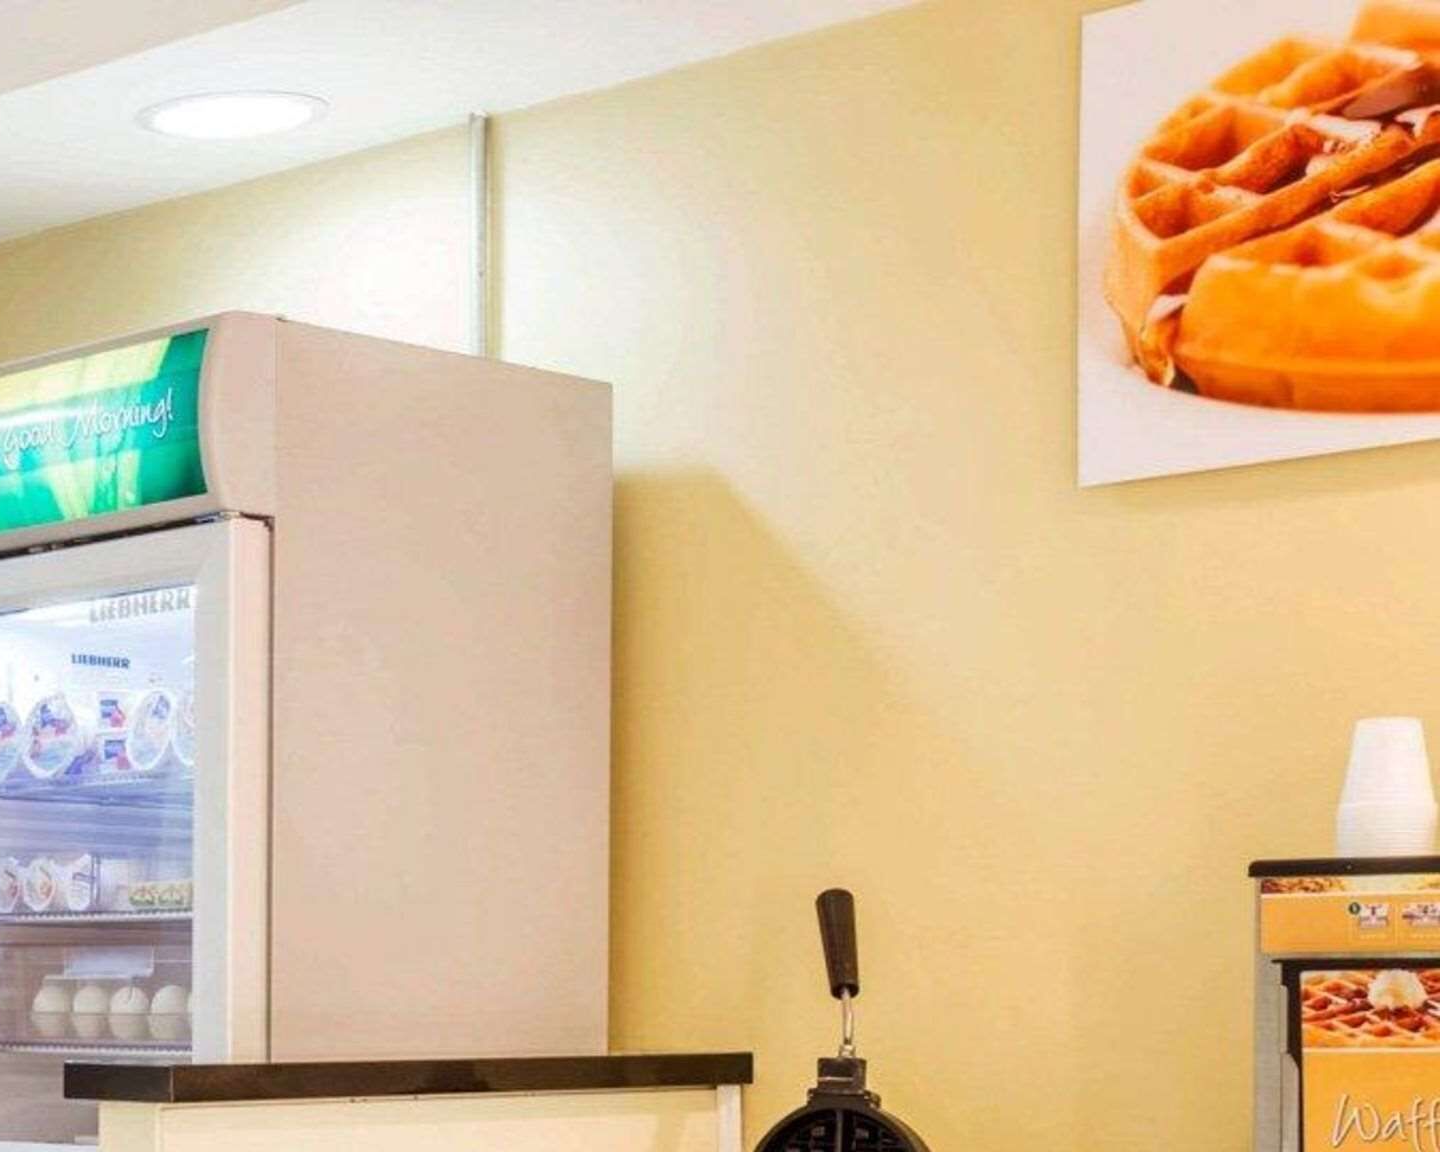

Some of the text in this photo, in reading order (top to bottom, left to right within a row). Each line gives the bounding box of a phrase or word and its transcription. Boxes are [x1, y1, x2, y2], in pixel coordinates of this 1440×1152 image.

[2, 388, 174, 467] Good Morning!
[89, 587, 192, 622] LIEBHERR
